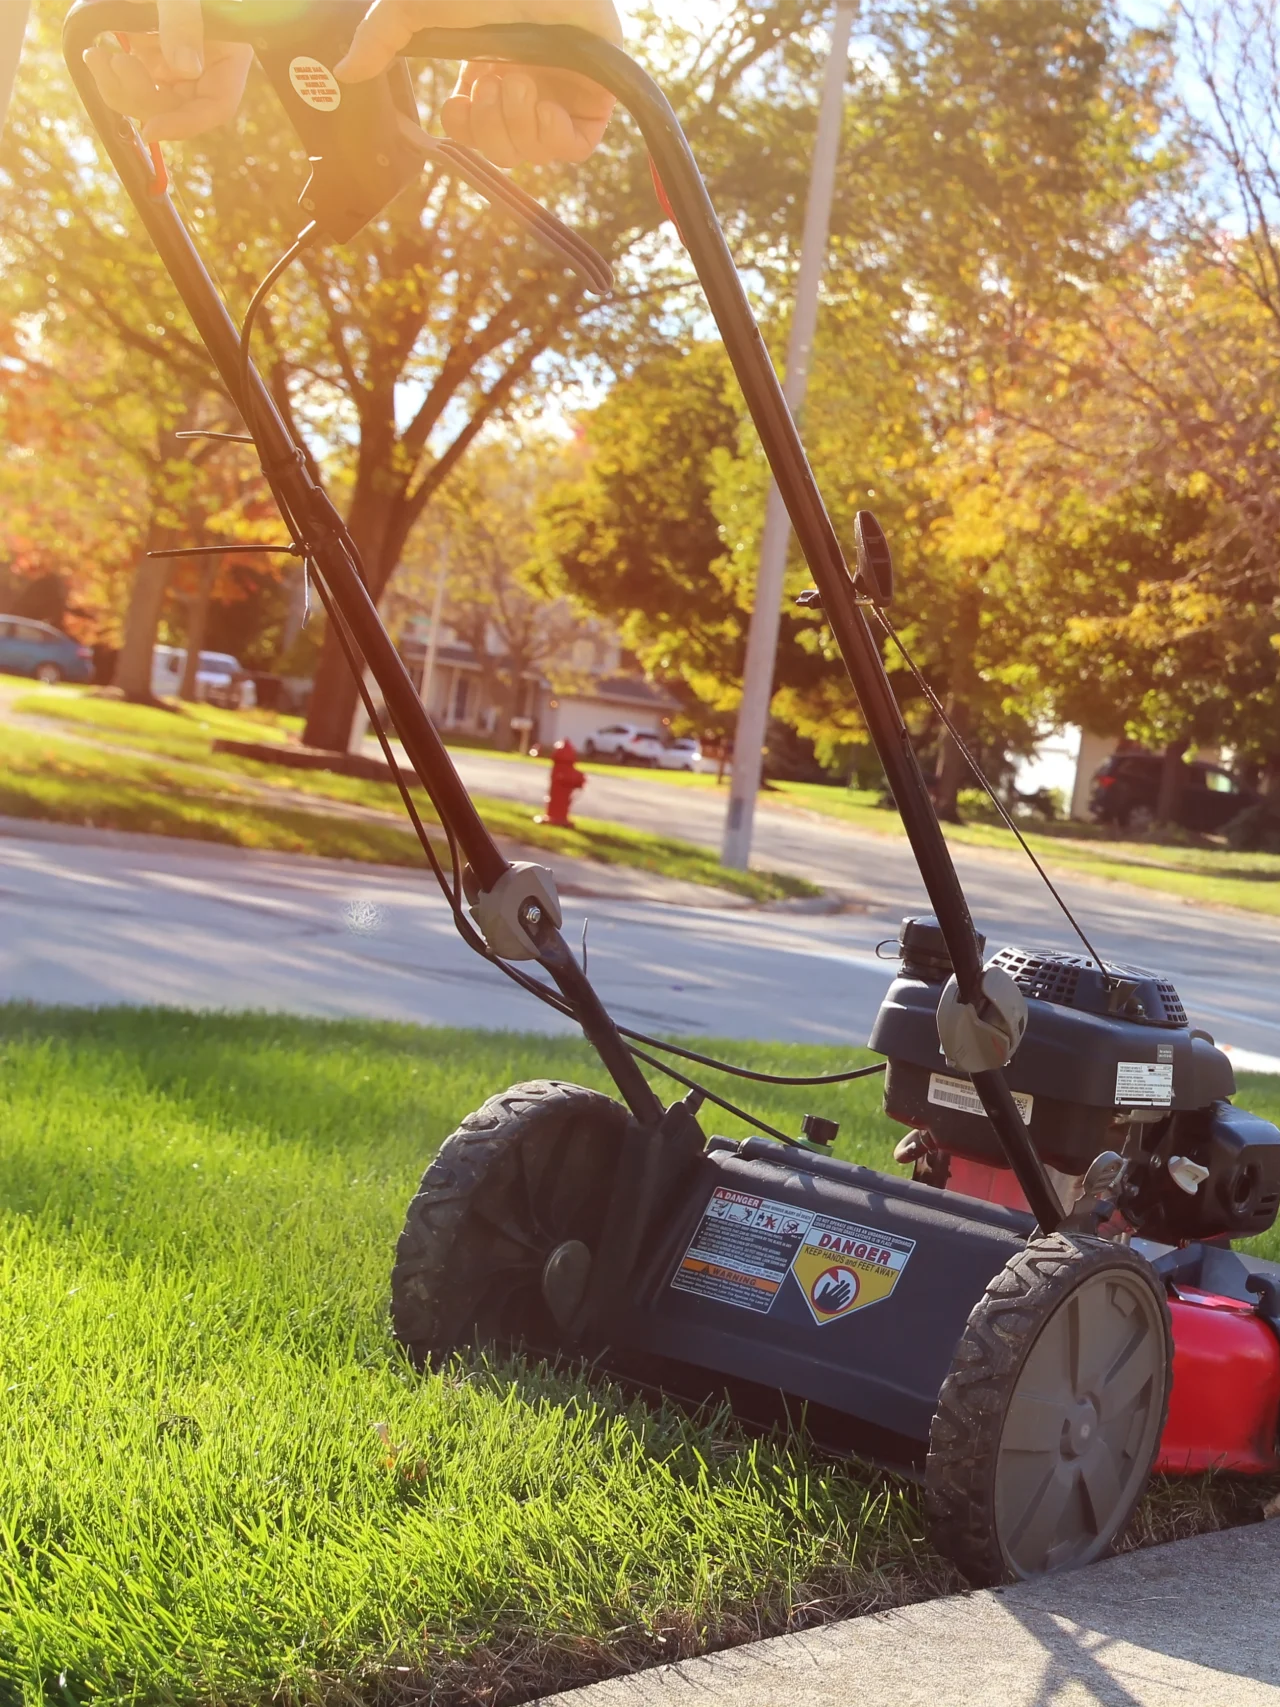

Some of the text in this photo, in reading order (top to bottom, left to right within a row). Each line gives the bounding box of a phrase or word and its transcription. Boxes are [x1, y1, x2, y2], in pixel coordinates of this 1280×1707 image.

[723, 1192, 760, 1207] DANGER
[829, 1220, 846, 1228] OPERATE
[845, 1224, 861, 1232] UNLESS
[867, 1230, 891, 1241] UNDAMAGED
[890, 1237, 912, 1247] DISCHARGE
[854, 1232, 871, 1240] CATCHER
[817, 1232, 892, 1265] DANGER
[804, 1246, 896, 1278] KEEP HANDS and FEET AWAY
[711, 1267, 757, 1285] WARNING
